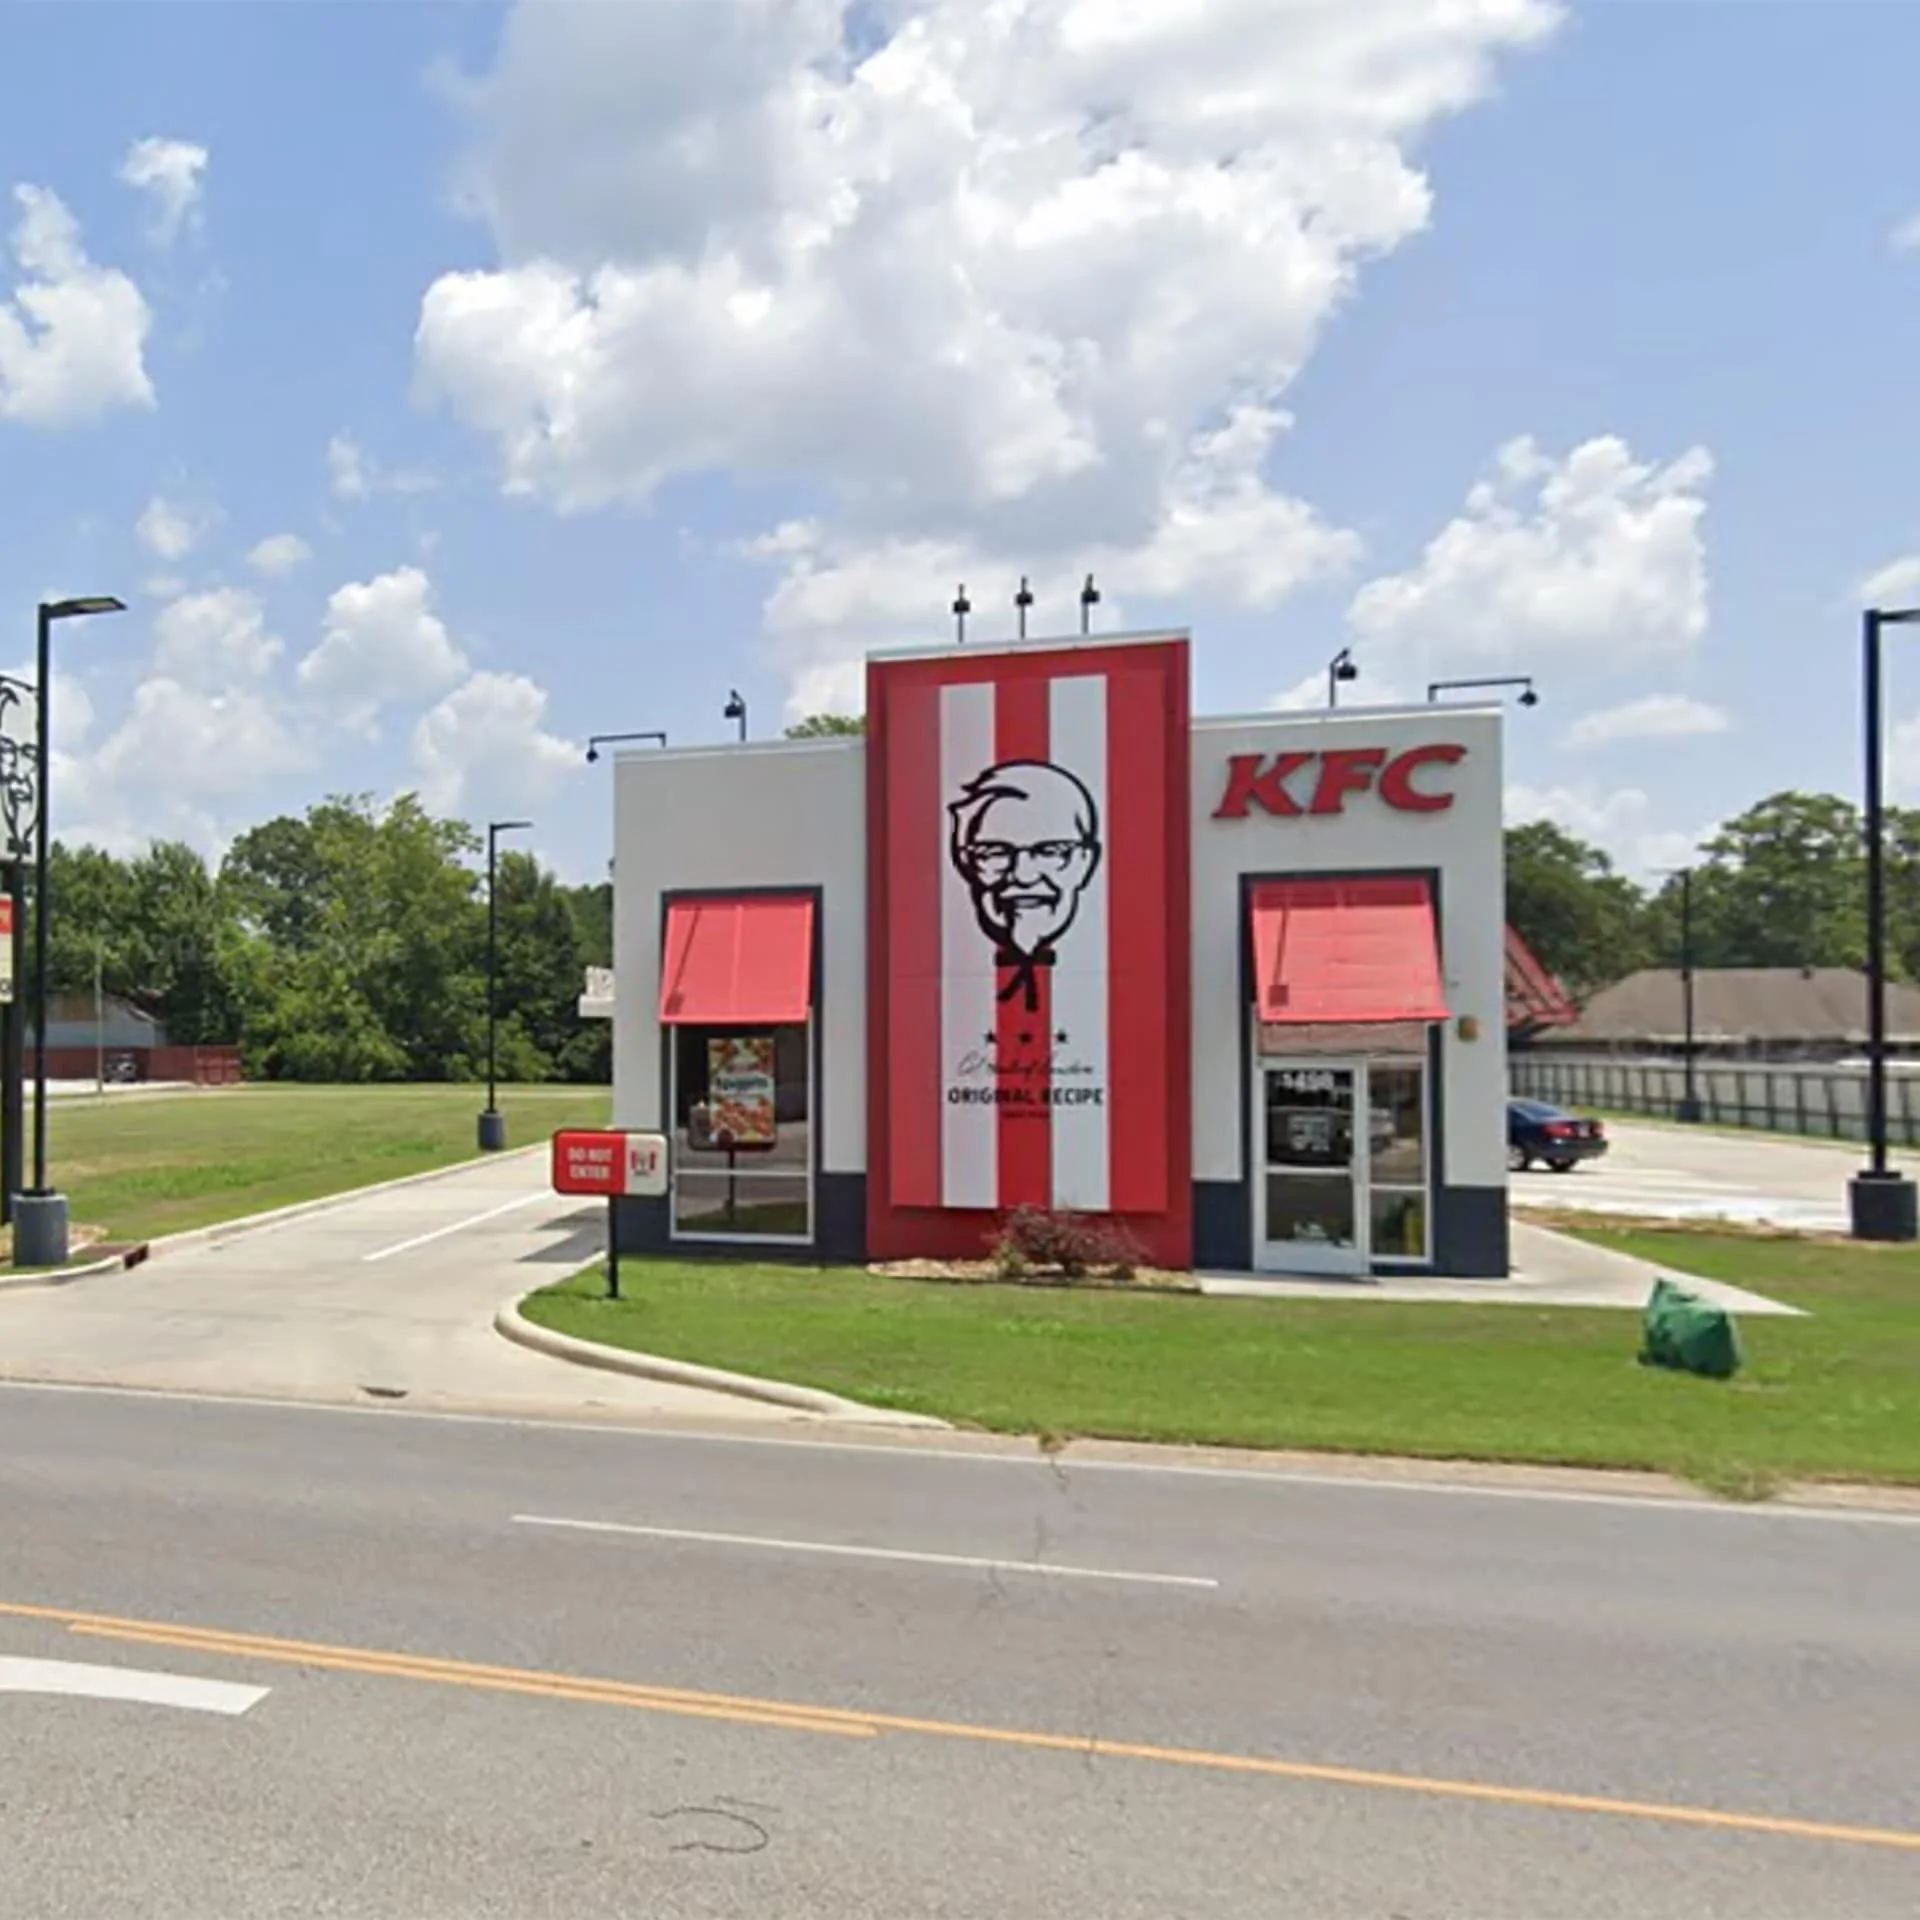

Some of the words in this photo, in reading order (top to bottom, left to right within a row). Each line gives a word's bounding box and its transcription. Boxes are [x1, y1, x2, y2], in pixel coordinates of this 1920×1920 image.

[1211, 743, 1469, 819] KFC
[948, 1087, 1034, 1104] ORIGINAL
[1041, 1087, 1104, 1105] RECIPE
